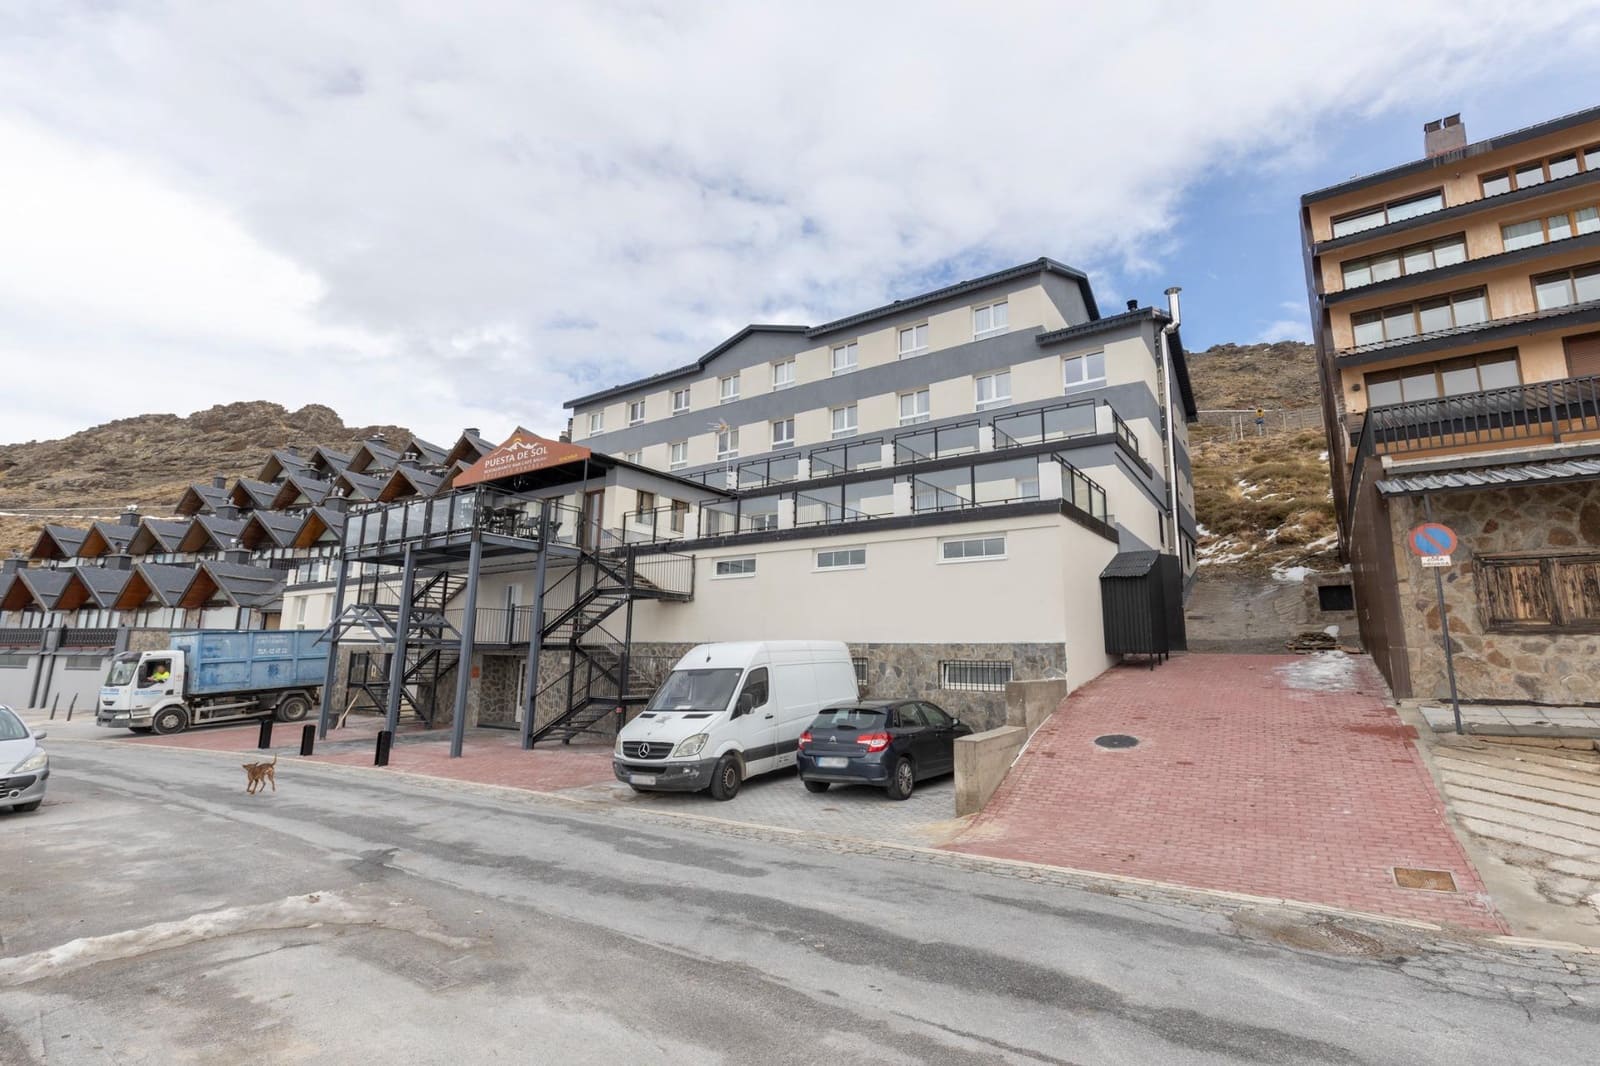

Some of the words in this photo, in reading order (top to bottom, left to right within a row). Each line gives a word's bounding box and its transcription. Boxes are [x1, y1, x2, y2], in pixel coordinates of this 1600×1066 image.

[485, 454, 516, 468] PUESTA
[517, 450, 529, 460] DE
[531, 446, 548, 457] SOL
